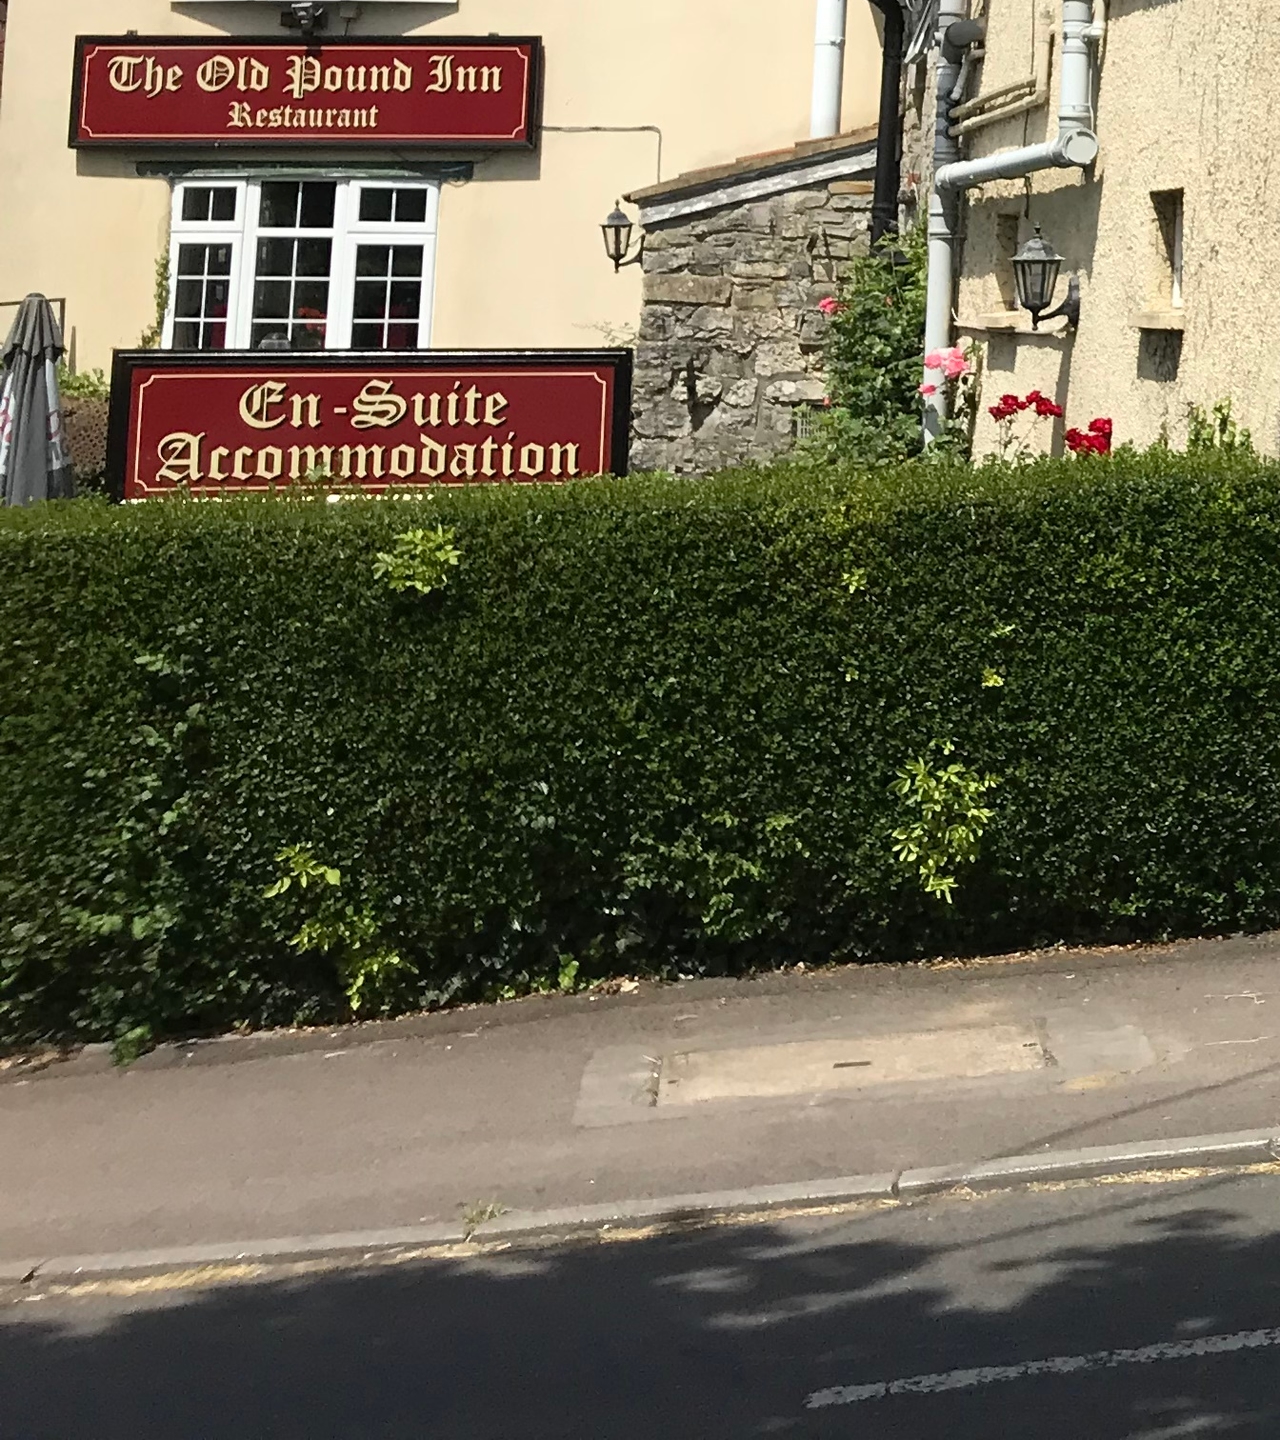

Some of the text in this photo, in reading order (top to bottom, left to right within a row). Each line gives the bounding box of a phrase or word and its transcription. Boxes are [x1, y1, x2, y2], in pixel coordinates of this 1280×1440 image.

[107, 55, 503, 98] The Old Pound Inn
[227, 101, 379, 128] Restaurant
[155, 430, 580, 482] Accommodation
